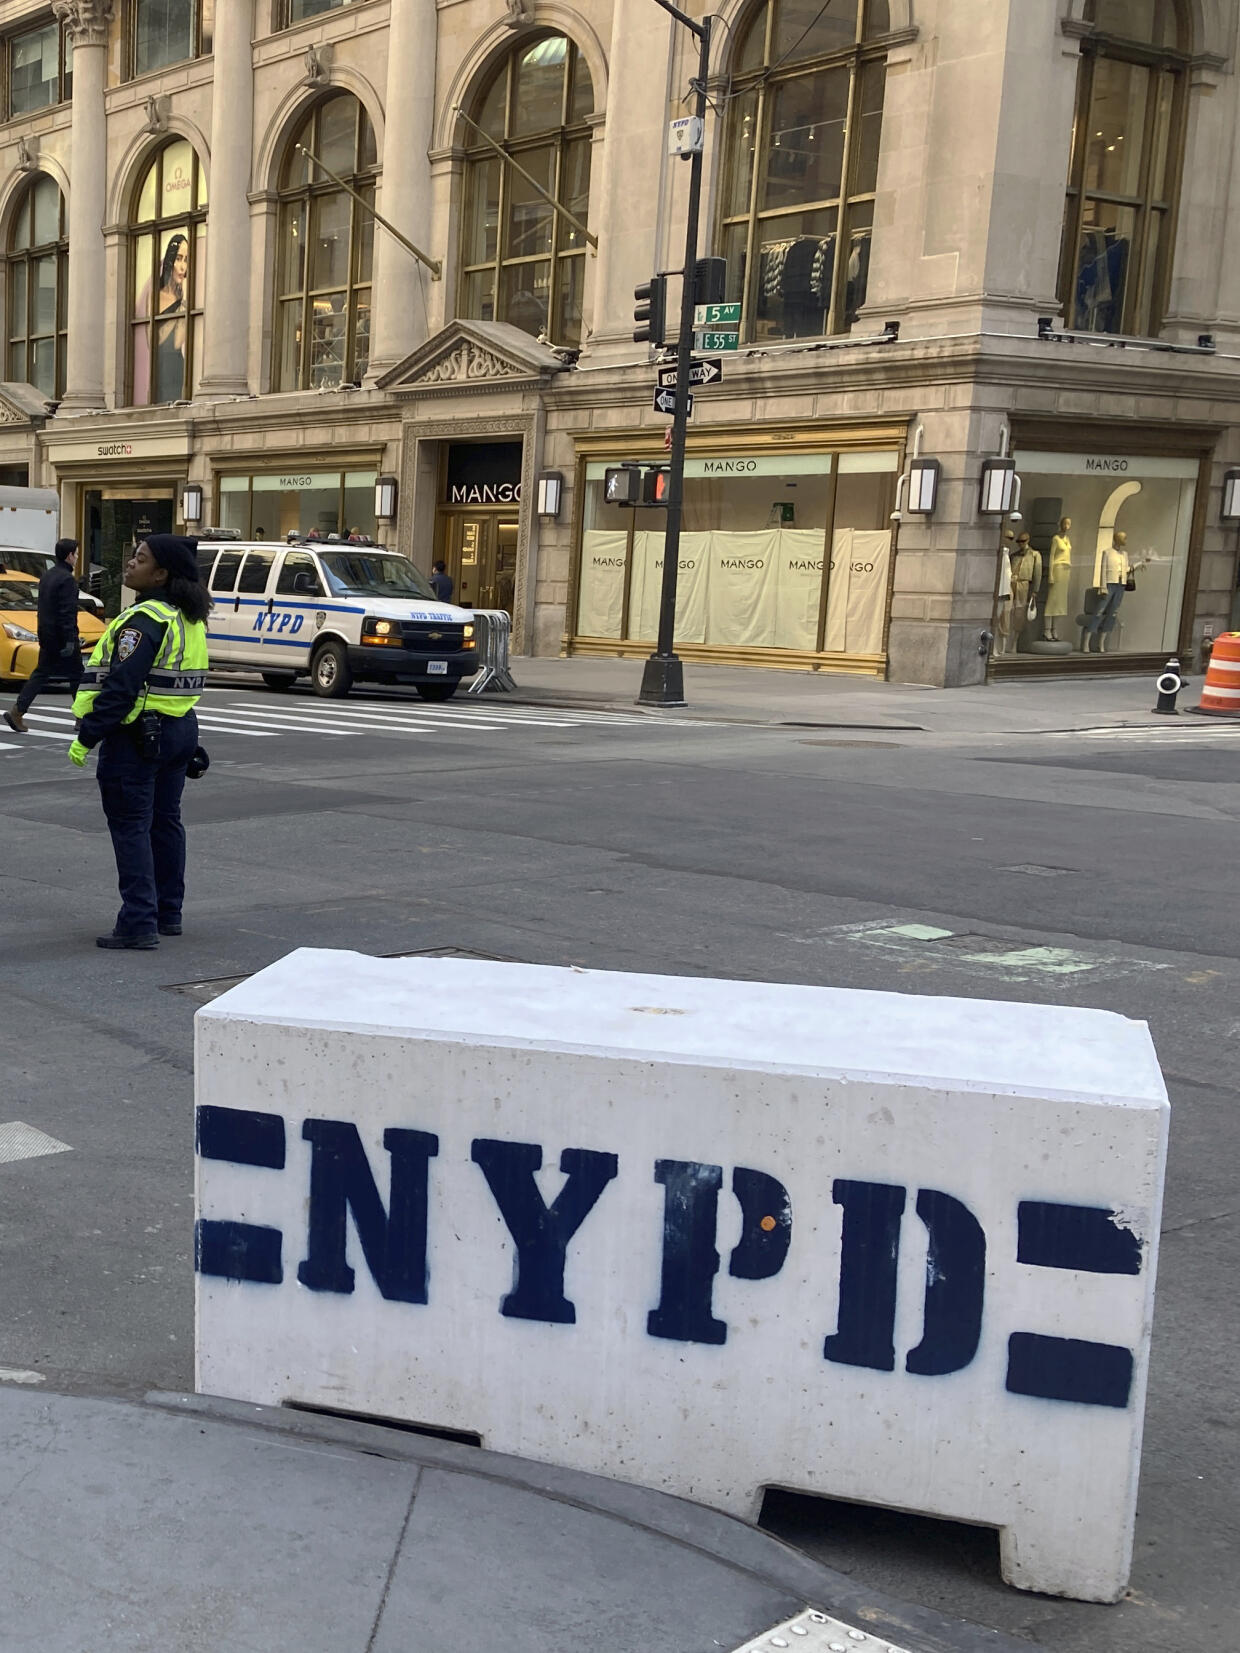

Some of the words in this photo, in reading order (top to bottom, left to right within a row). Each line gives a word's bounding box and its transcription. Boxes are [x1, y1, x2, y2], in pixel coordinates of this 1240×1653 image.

[711, 306, 721, 322] 5
[724, 306, 735, 314] AV
[704, 334, 711, 349] E
[713, 334, 725, 349] 55
[728, 334, 737, 343] ST
[691, 367, 712, 379] WAY
[660, 395, 672, 407] ONE
[97, 444, 127, 456] swatch
[704, 461, 757, 472] MANGO
[1086, 459, 1128, 471] MANGO
[280, 476, 312, 487] MANGO
[655, 560, 696, 569] MGO
[720, 559, 764, 569] MANGO
[789, 560, 836, 571] MANGO
[252, 611, 304, 634] NYPD
[410, 612, 427, 620] NYPD
[428, 613, 453, 621] TRAFFIC
[297, 1116, 986, 1376] NYPD
